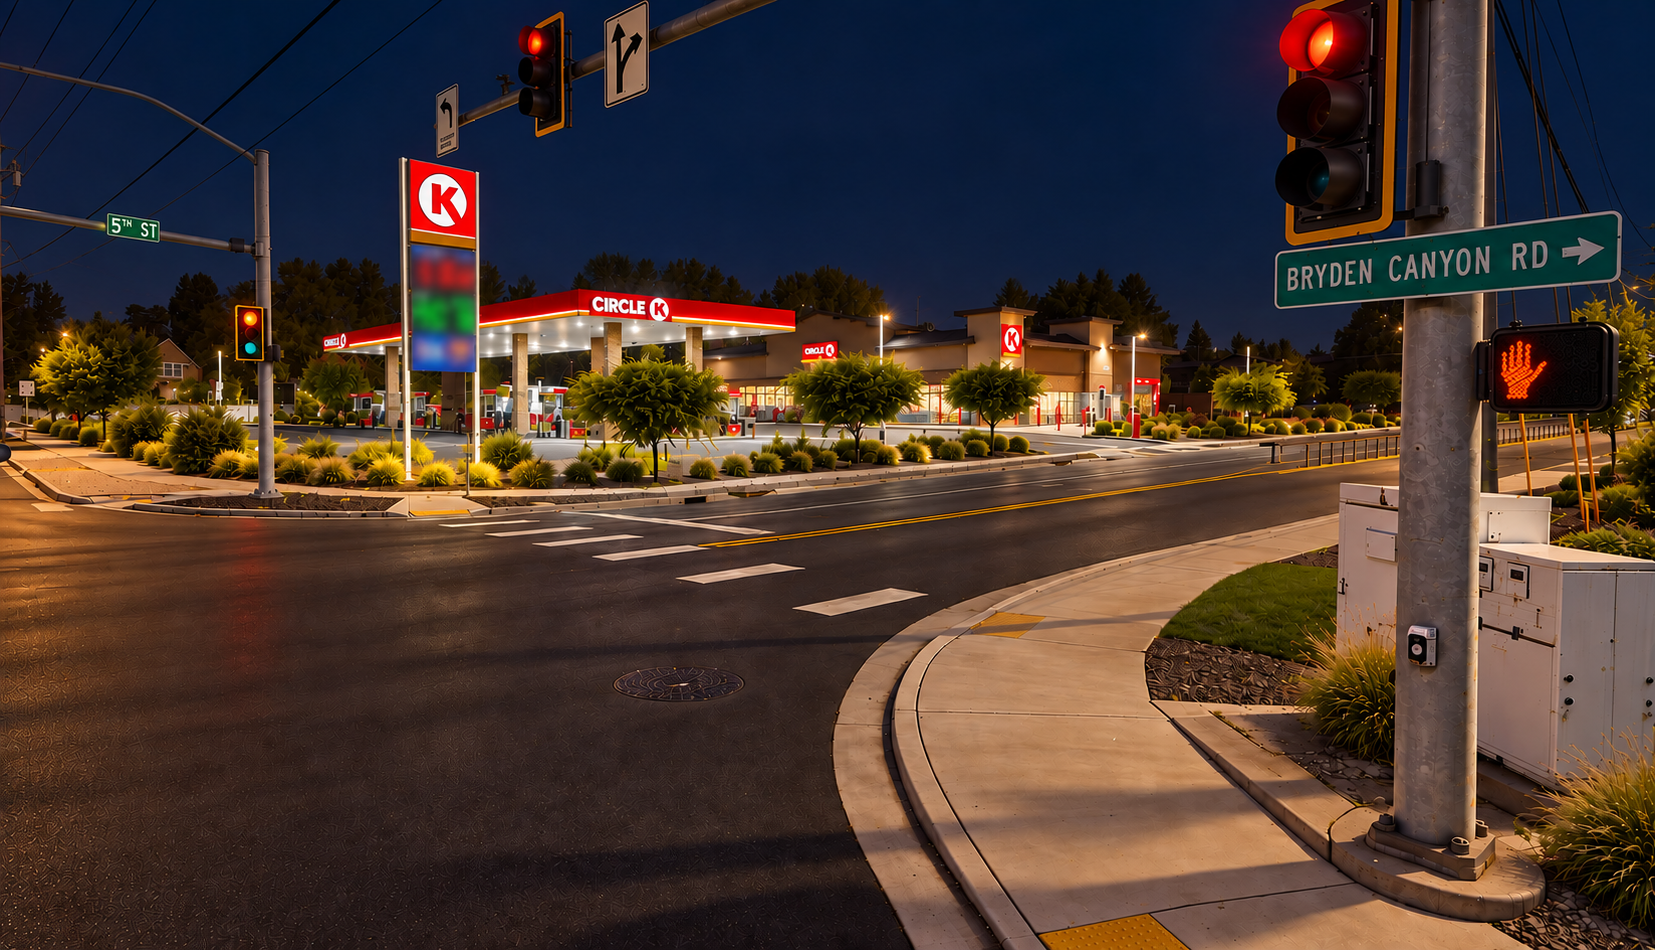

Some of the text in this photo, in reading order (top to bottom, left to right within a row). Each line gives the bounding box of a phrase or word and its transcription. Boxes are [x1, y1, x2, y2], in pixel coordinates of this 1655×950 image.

[429, 180, 464, 226] K
[111, 217, 157, 238] 5TH ST
[1286, 240, 1548, 292] BRYDEN CANYON RD
[591, 296, 668, 319] CIRCLE K
[1006, 330, 1018, 350] K
